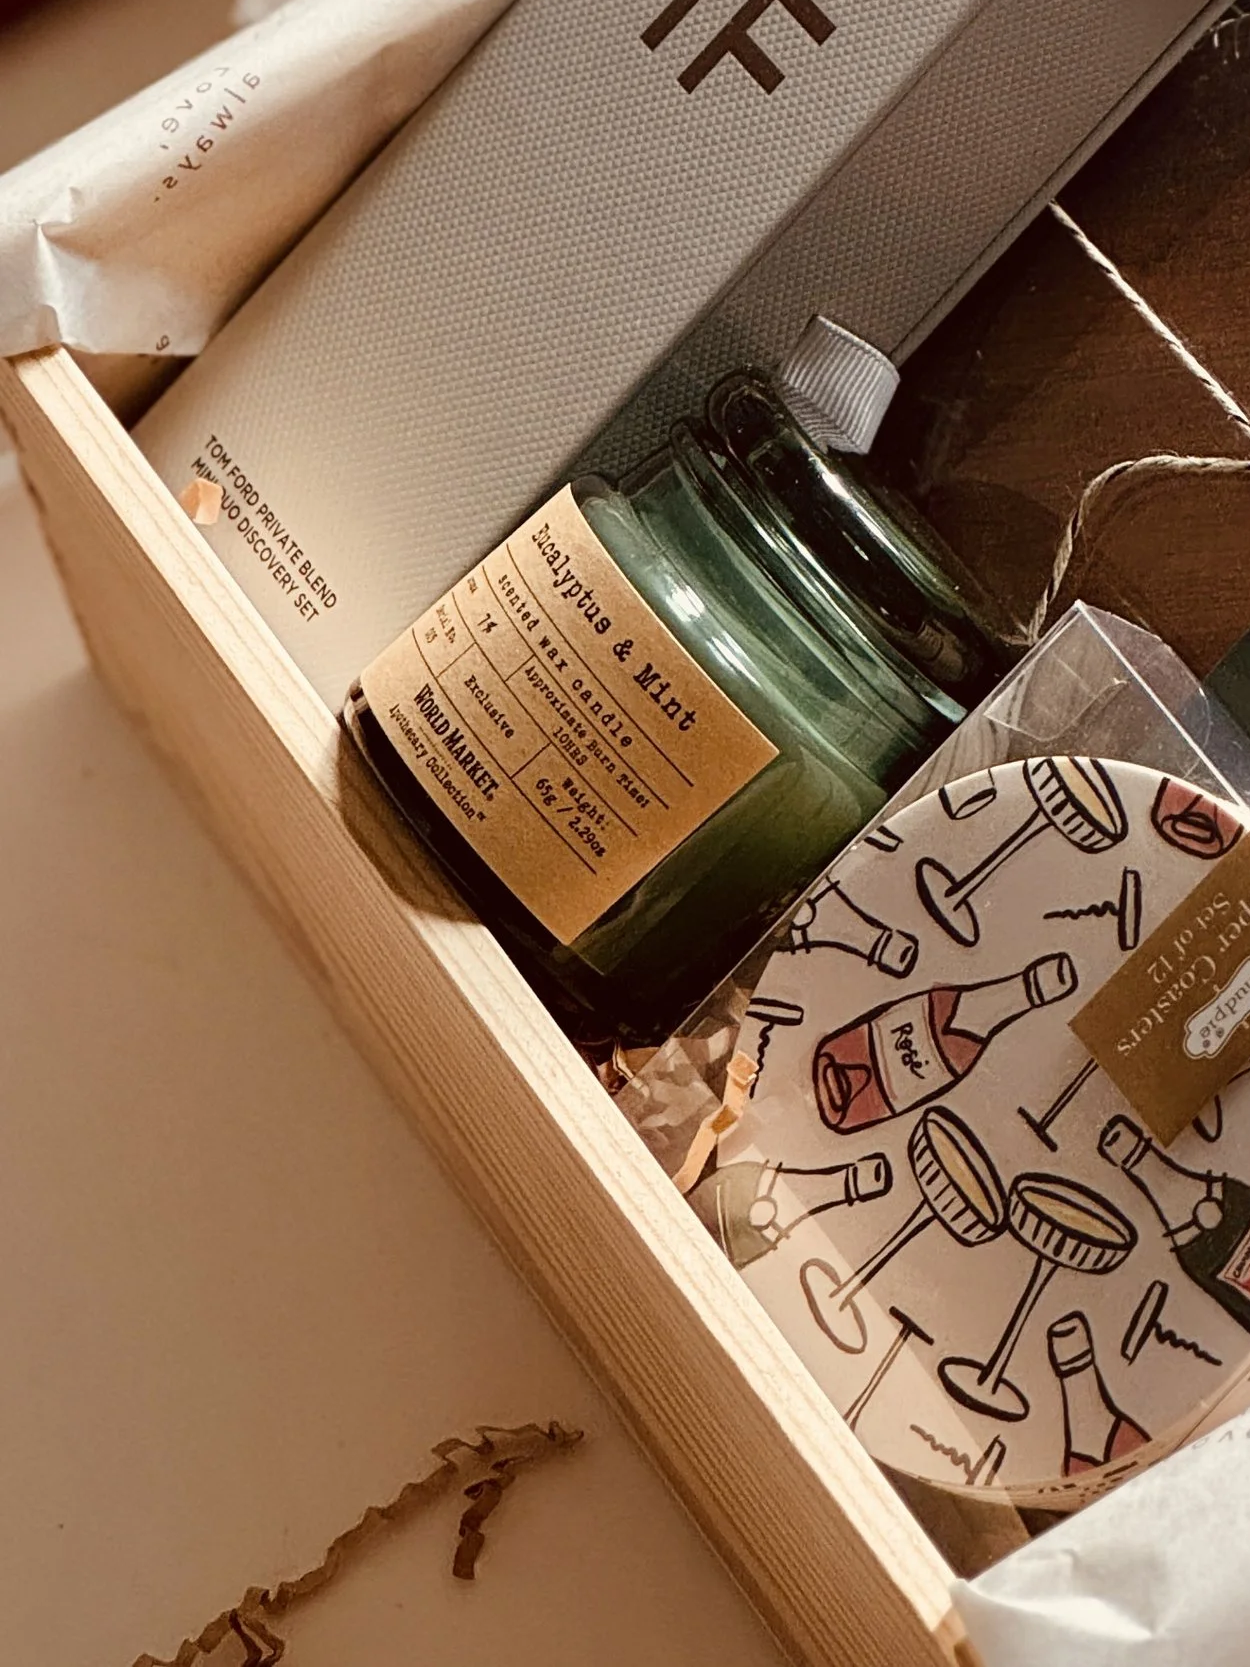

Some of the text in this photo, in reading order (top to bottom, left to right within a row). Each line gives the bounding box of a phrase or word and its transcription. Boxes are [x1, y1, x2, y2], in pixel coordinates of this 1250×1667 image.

[205, 434, 338, 609] TOM FORD PRIVATE BLEND
[237, 517, 299, 595] DISCOVERY
[294, 593, 320, 622] SET
[498, 574, 633, 748] scented wax candle
[532, 523, 696, 731] Eucalyptus & Mint
[414, 683, 450, 735] WORLD
[464, 675, 515, 738] Exclusive
[525, 666, 650, 808] Approximate Burn Time:
[536, 779, 557, 806] 65g
[569, 816, 607, 857] 2.29oz
[561, 778, 609, 830] Weight:
[1147, 892, 1231, 984] Set of 12
[1117, 955, 1216, 1056] Coasters
